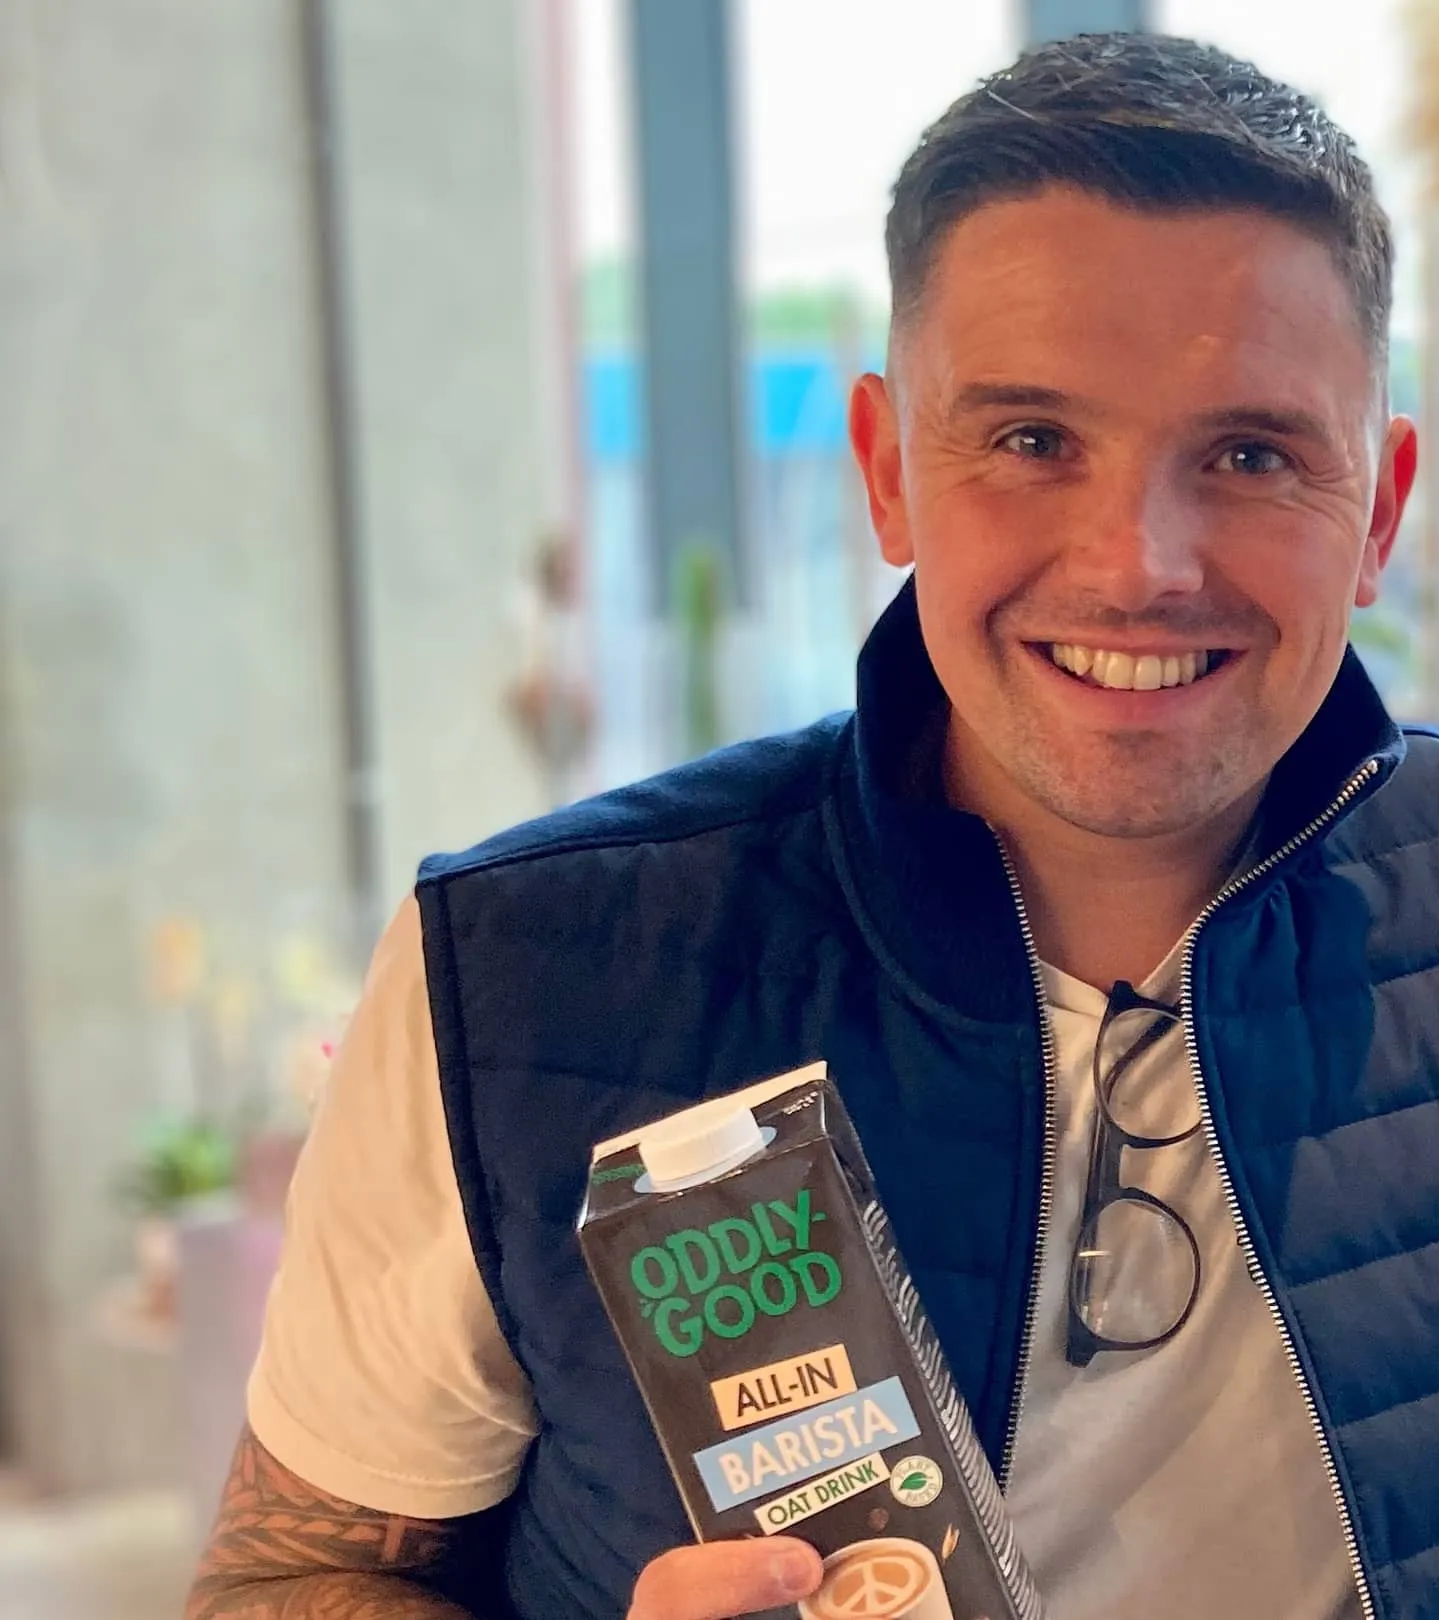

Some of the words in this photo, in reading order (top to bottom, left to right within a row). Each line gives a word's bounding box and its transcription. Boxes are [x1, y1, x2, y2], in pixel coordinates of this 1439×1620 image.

[650, 1251, 842, 1357] GOOD
[736, 1357, 838, 1417] ALL-IN
[719, 1399, 898, 1494] BARISTA
[767, 1493, 813, 1526] OAT
[815, 1460, 879, 1504] DRINK
